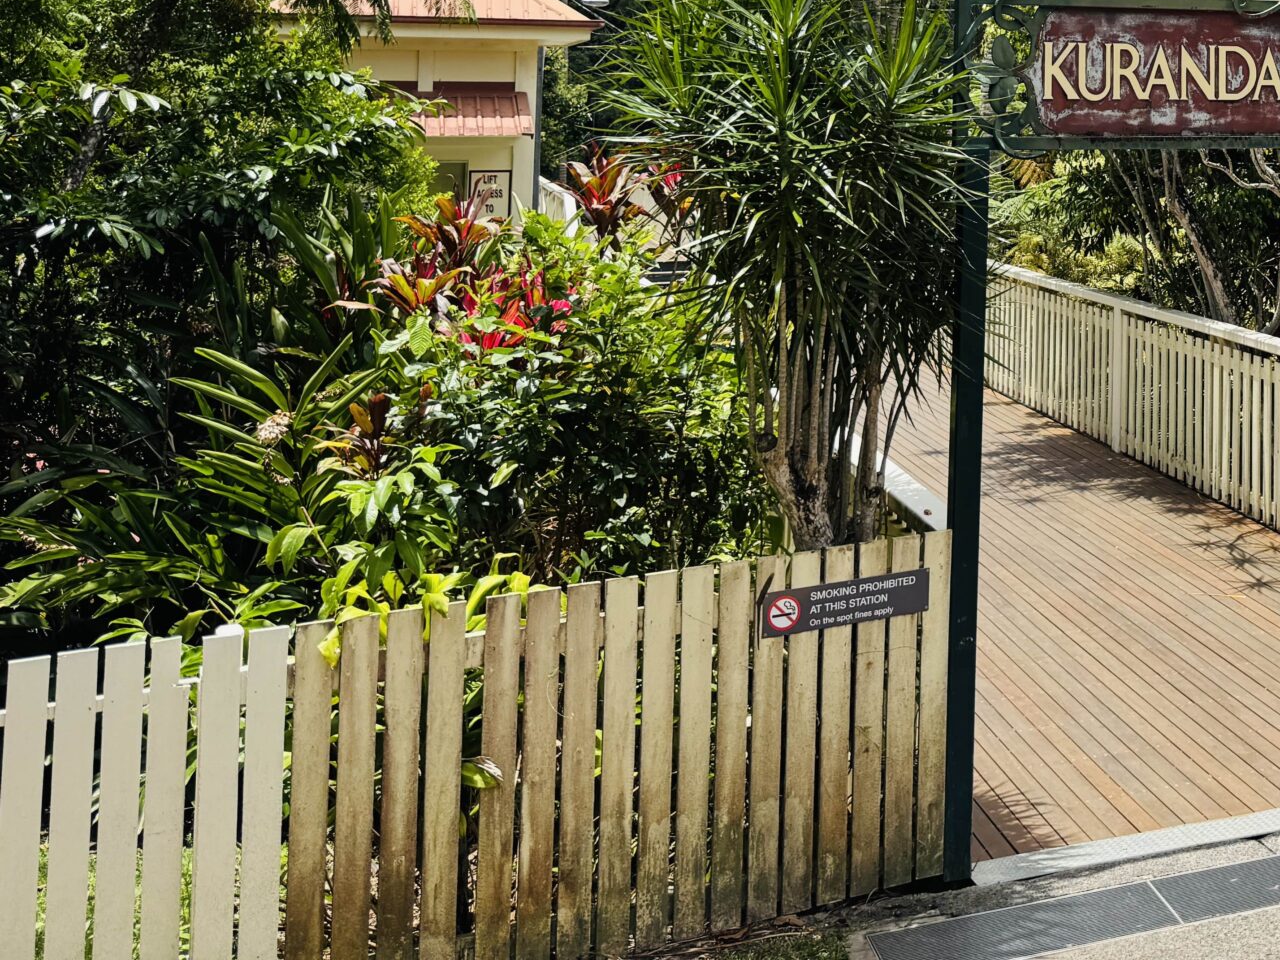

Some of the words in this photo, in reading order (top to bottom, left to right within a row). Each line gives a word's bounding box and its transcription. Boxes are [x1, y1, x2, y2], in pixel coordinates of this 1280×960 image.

[483, 174, 498, 184] LIFT
[476, 189, 503, 198] AESS
[485, 204, 494, 213] TO
[810, 585, 857, 601] SMOKING
[859, 575, 916, 593] PROHIBITED
[809, 604, 822, 615] AT
[824, 600, 847, 612] THIS
[849, 593, 889, 608] STATION
[809, 618, 821, 627] On
[822, 615, 835, 625] the
[836, 612, 853, 626] spot
[854, 610, 872, 620] fines
[873, 606, 894, 619] apply
